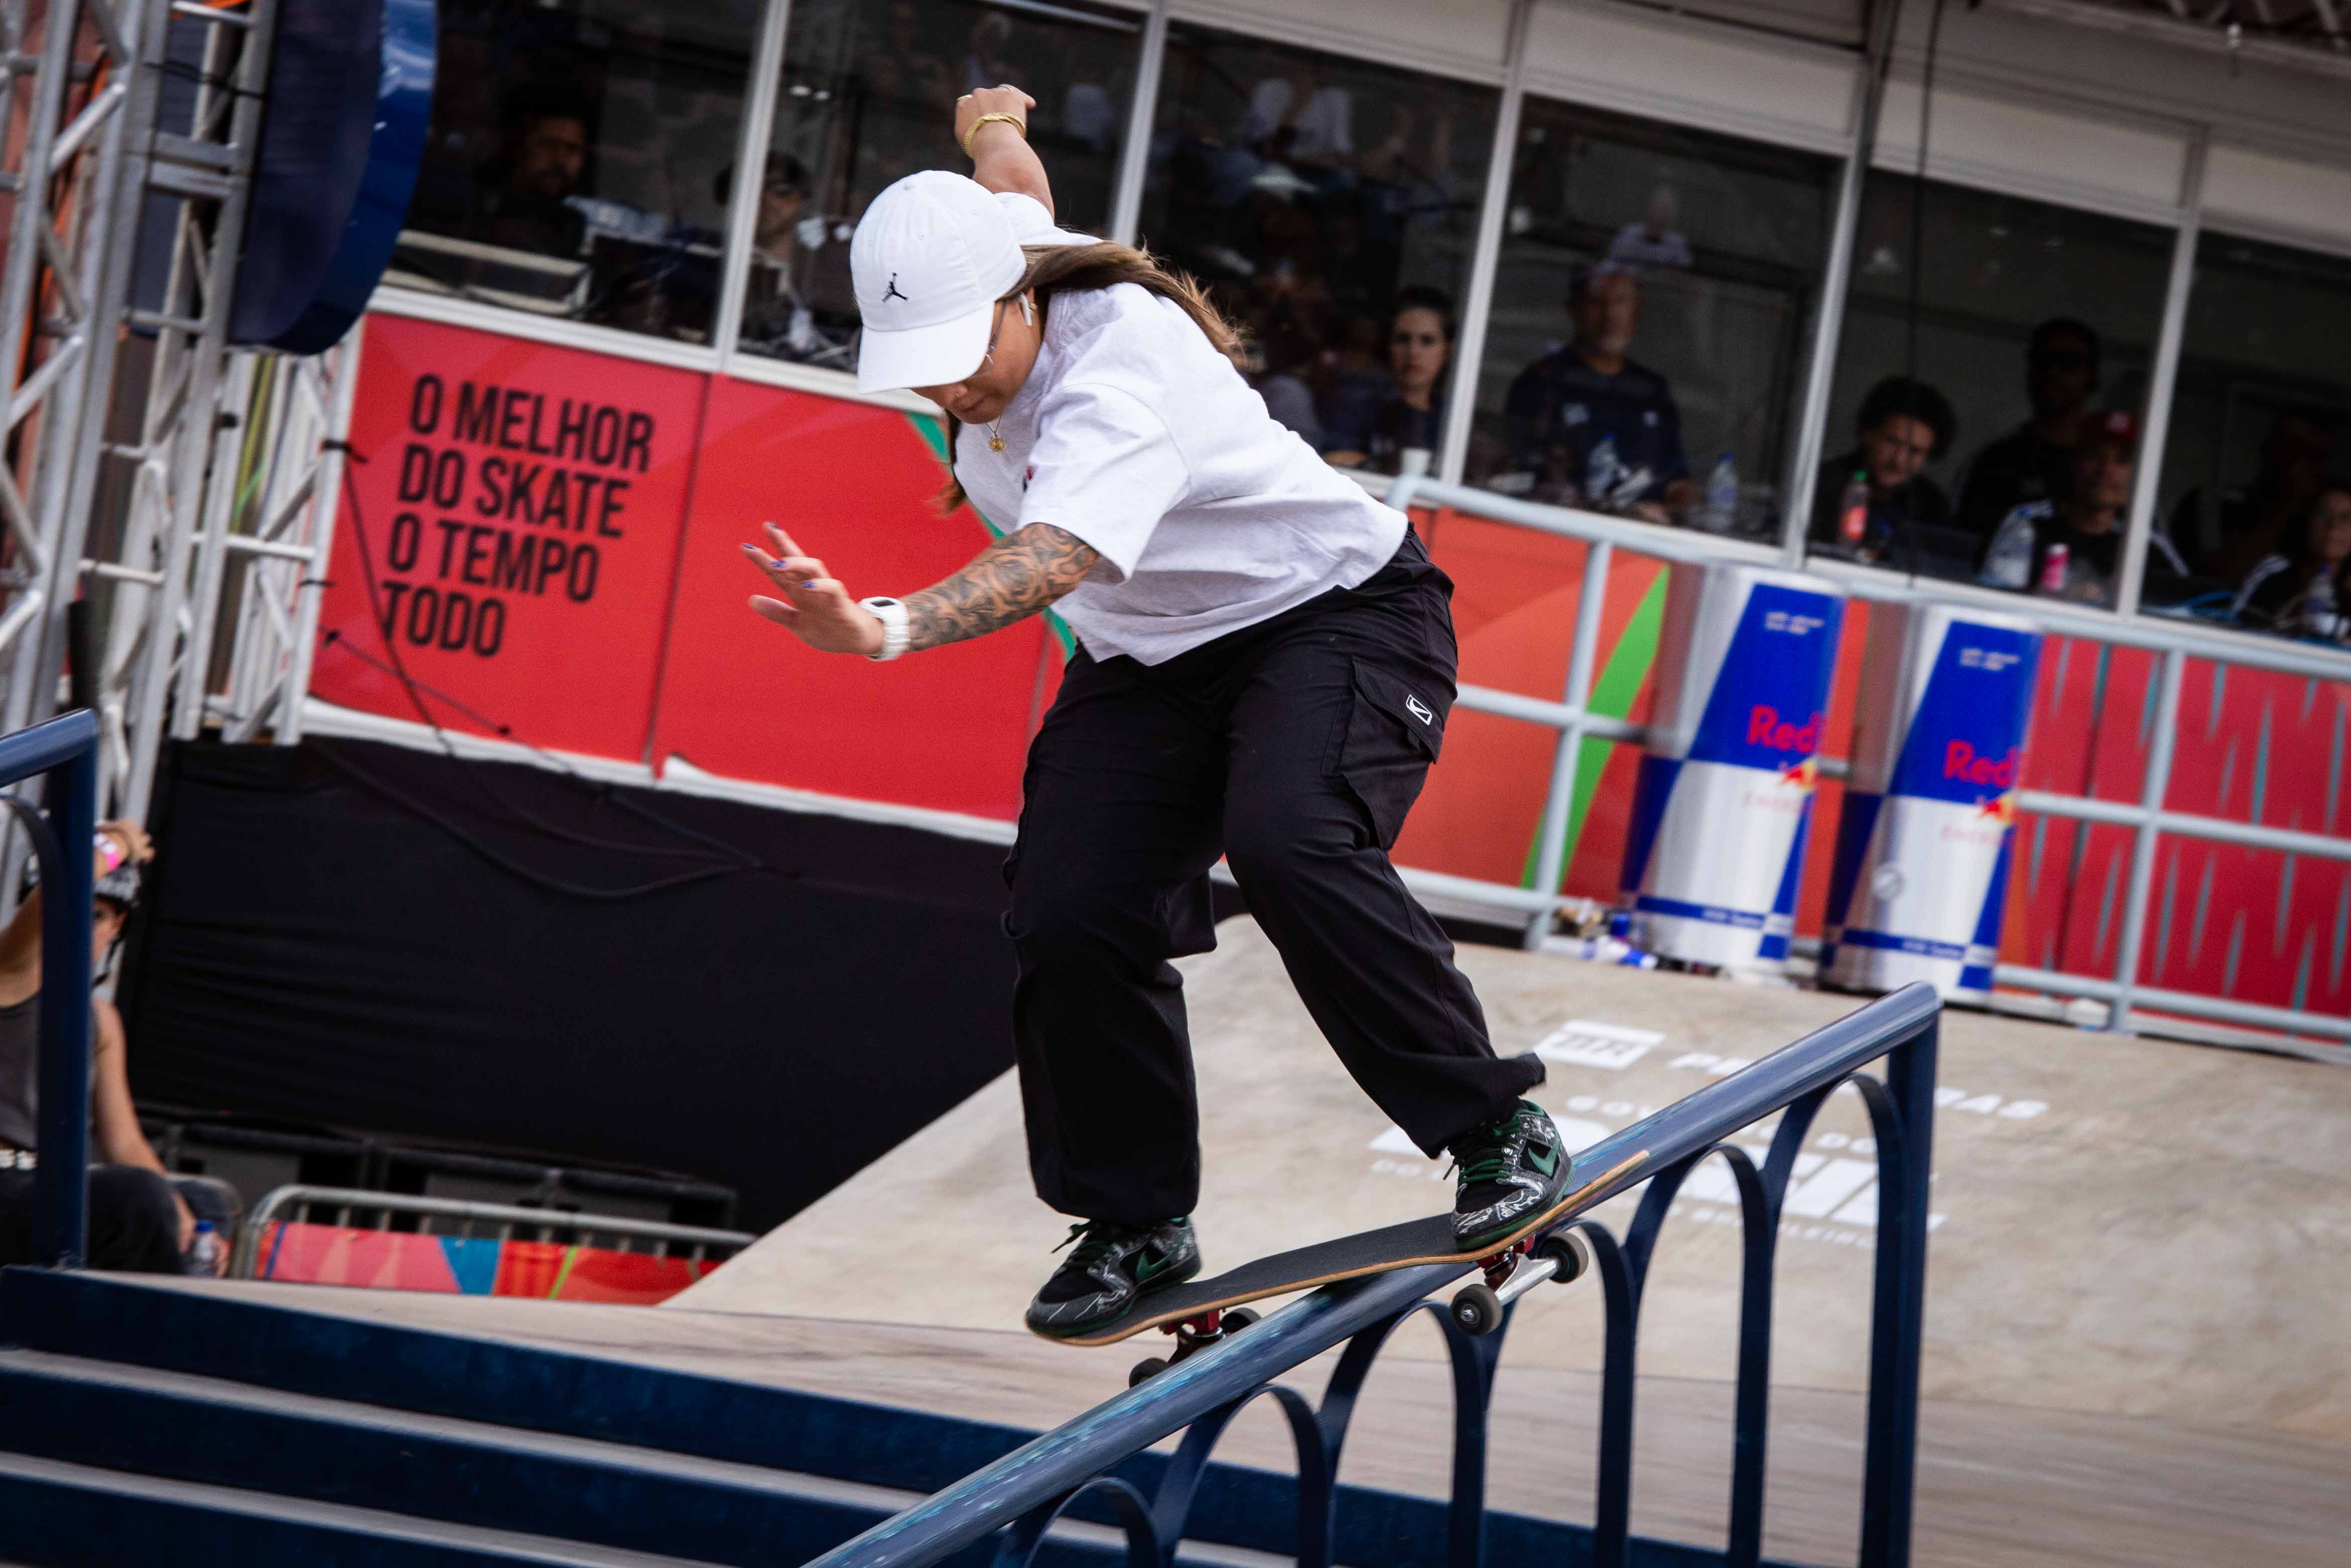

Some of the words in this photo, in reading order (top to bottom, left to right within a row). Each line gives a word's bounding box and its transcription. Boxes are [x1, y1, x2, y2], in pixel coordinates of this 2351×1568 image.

[408, 373, 445, 436] O
[452, 380, 655, 474] MELHOR
[397, 442, 467, 510] DO
[475, 456, 631, 539] SKATE
[387, 511, 423, 574] O
[436, 518, 600, 604] TEMPO
[379, 579, 507, 659] TODO
[1746, 703, 1824, 753] Red
[1942, 739, 2020, 788] Red
